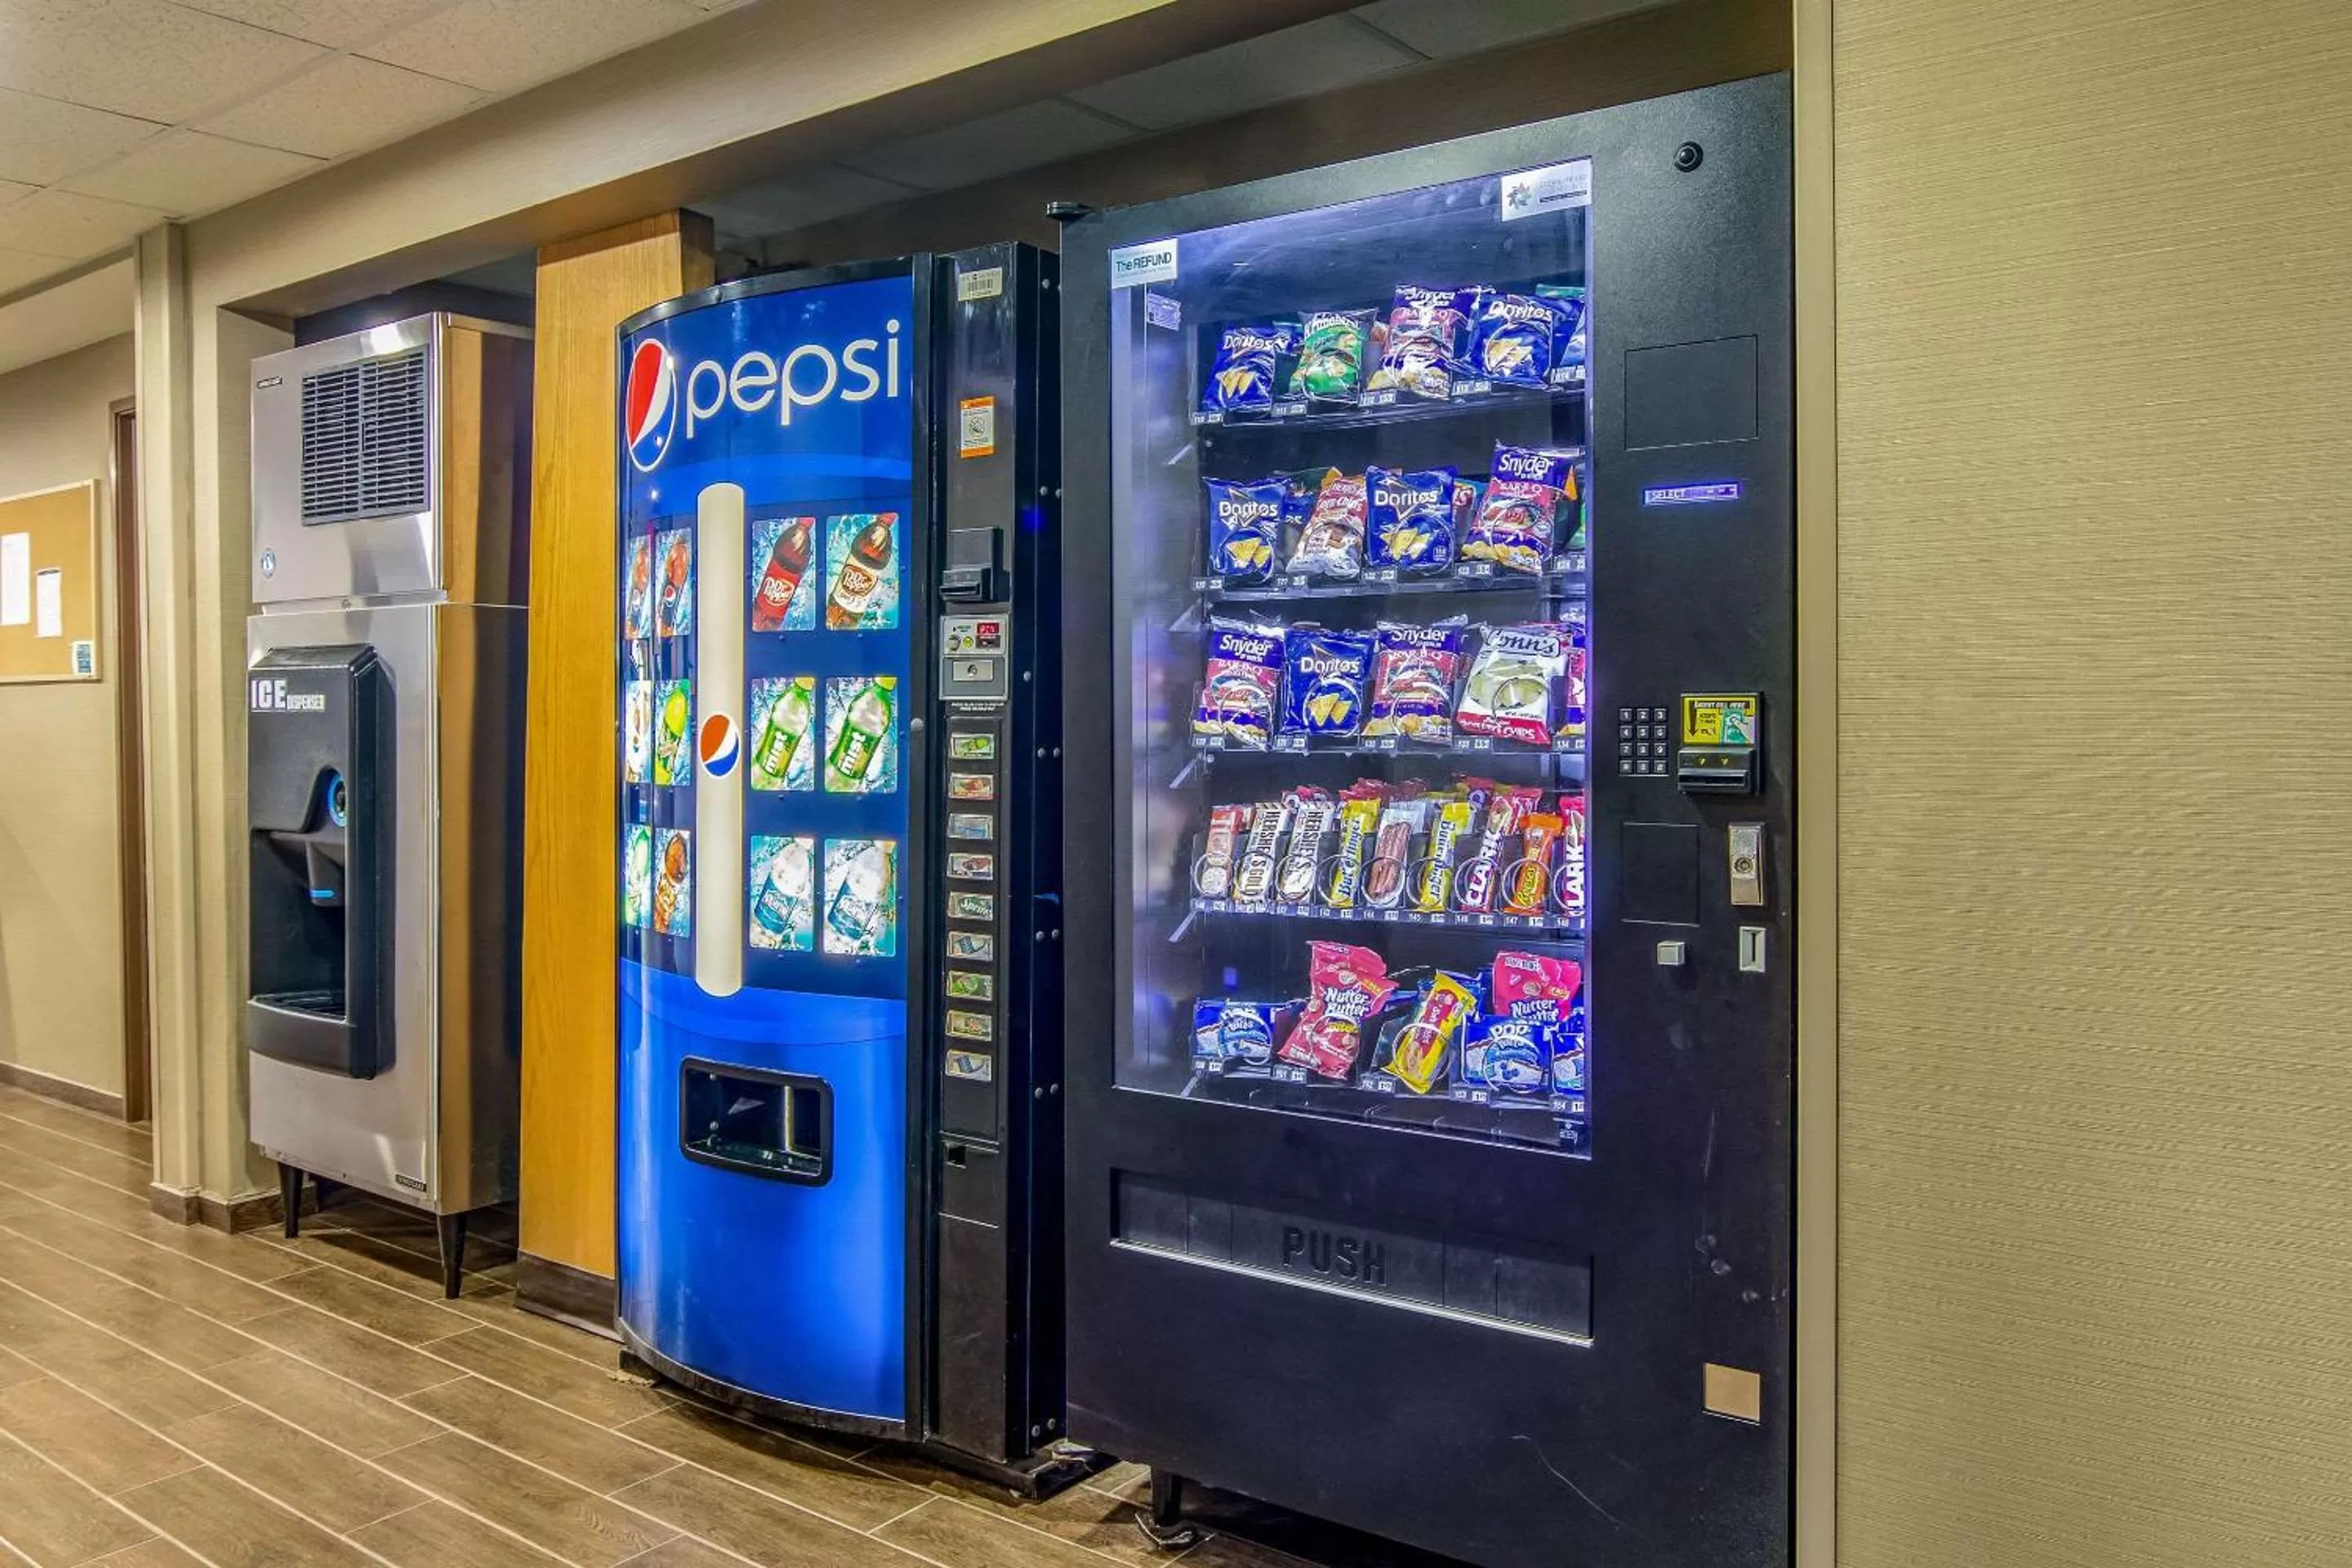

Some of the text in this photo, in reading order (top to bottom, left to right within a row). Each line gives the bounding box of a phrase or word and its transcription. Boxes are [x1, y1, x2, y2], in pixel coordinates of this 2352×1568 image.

[1116, 261, 1133, 272] The
[1134, 252, 1172, 270] REFUND
[1488, 300, 1552, 322] Doritos
[685, 318, 901, 439] pepsi
[1374, 489, 1438, 506] Doritos
[1650, 489, 1686, 500] SELECT
[1218, 501, 1278, 518] Doritos
[1219, 635, 1274, 657] Snyder
[1390, 629, 1448, 645] Snyder
[1300, 656, 1361, 673] Doritos
[251, 679, 286, 708] ICE
[840, 731, 866, 776] mist
[1324, 987, 1370, 1004] Nutter
[1325, 1002, 1370, 1015] Butter
[1510, 999, 1557, 1018] Nutter
[1283, 1225, 1388, 1287] PUSH
